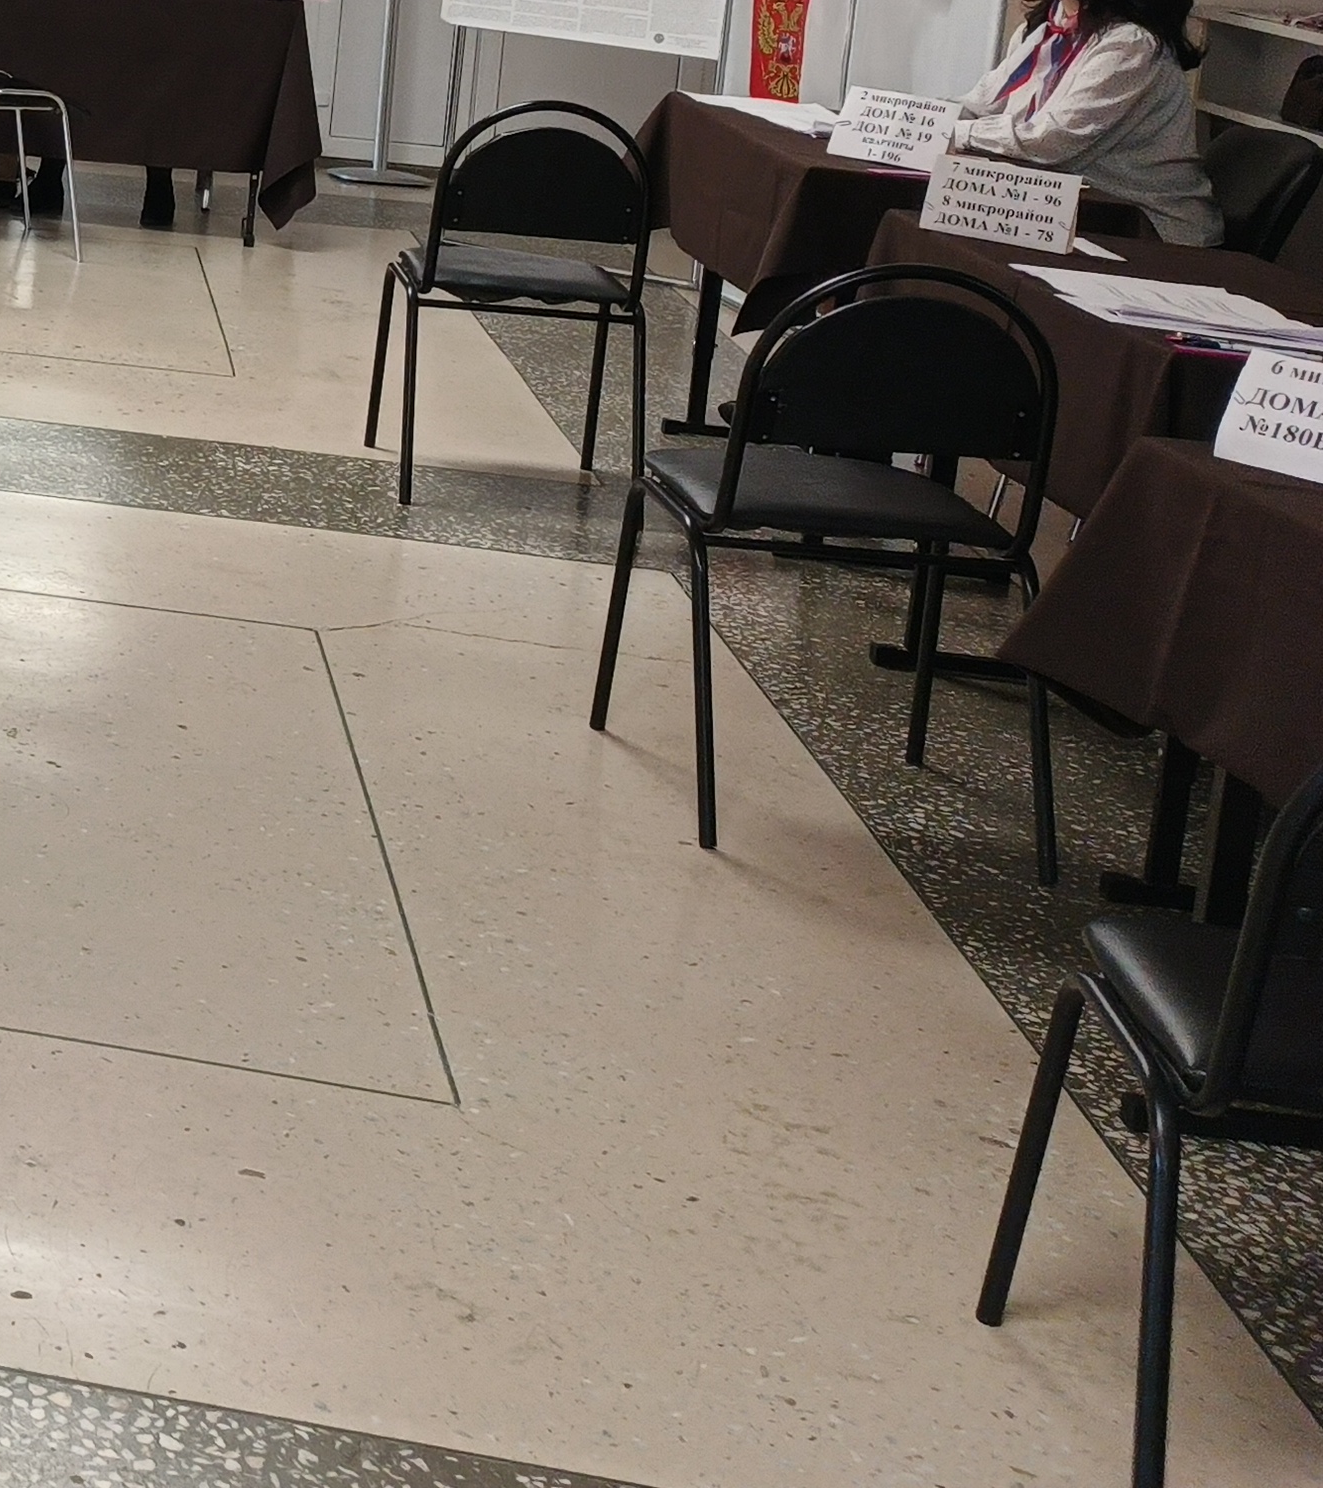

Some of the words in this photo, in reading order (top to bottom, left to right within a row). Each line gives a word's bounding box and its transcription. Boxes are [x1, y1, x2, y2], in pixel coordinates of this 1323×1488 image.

[861, 90, 868, 100] 2
[871, 94, 947, 114] микрорайон
[860, 106, 897, 120] ДОМ
[898, 112, 916, 124] №
[921, 116, 935, 128] 16
[852, 121, 889, 135] ДОМ
[895, 128, 912, 140] №
[917, 132, 932, 143] 19
[953, 162, 961, 172] 7
[963, 166, 1063, 190] микрорайон
[942, 178, 997, 197] ДОМА
[1001, 188, 1028, 202] №1
[1045, 194, 1062, 207] 96
[942, 194, 952, 206] 8
[955, 200, 1054, 224] микрорайон
[934, 211, 989, 231] ДОМА
[994, 222, 1019, 237] №1
[1037, 230, 1054, 243] 78
[1271, 360, 1285, 374] 6
[1290, 367, 1323, 384] ми
